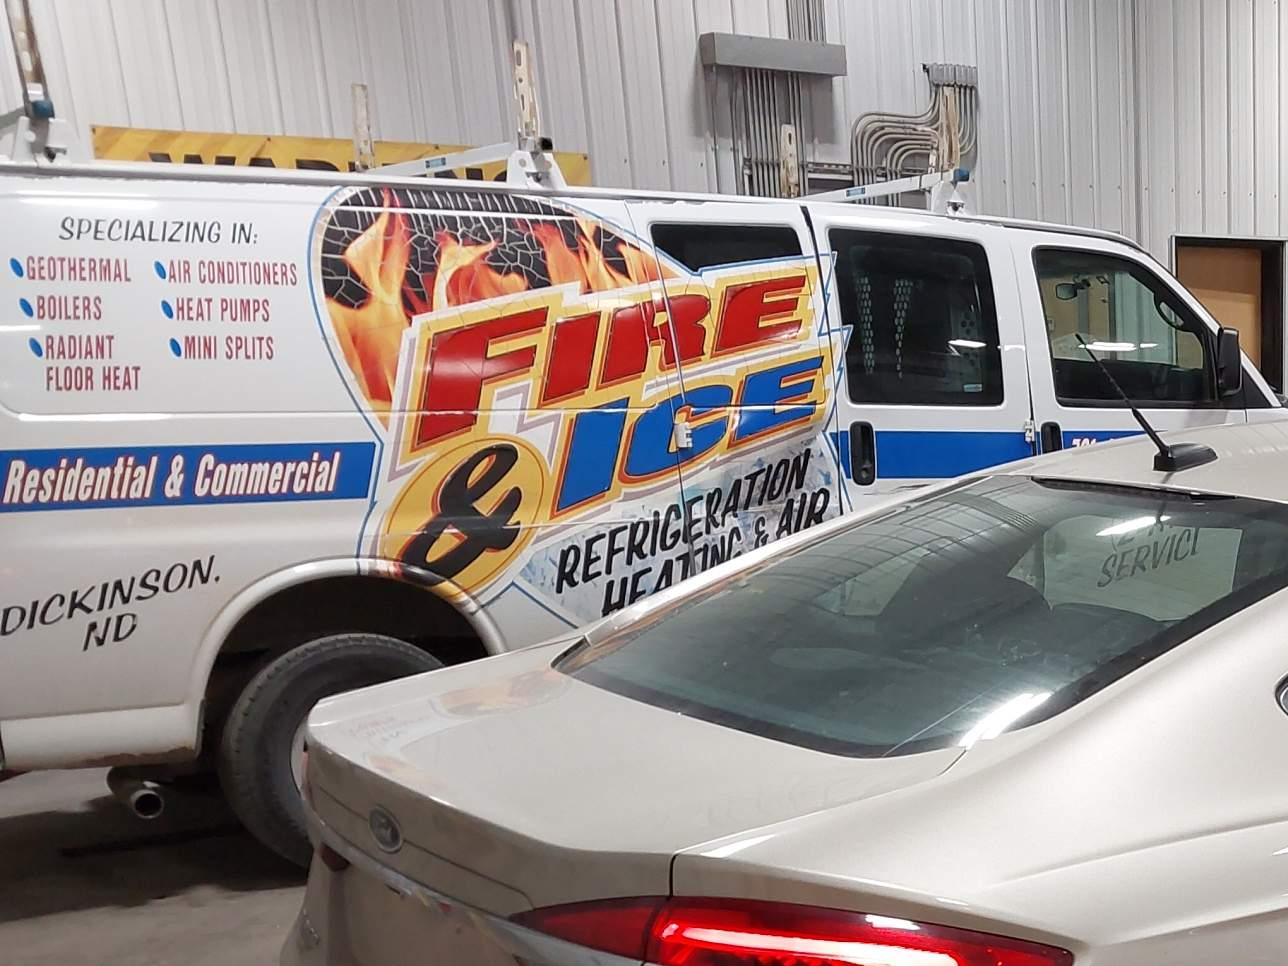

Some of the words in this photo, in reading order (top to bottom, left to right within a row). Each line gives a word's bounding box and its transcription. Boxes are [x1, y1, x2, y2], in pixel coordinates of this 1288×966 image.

[58, 216, 221, 244] SPECIALIZING
[230, 222, 258, 245] IN:
[26, 256, 132, 283] GEOTHERMAL
[168, 260, 192, 285] AIR
[199, 260, 298, 287] CONDITIONERS
[36, 295, 102, 321] BOILERS
[176, 297, 213, 323] HEAT
[220, 298, 271, 323] PUMPS
[45, 334, 115, 361] RADIANT
[184, 336, 217, 360] MINI
[225, 336, 274, 361] SPLITS
[413, 275, 808, 450] FIRE
[46, 366, 94, 392] FLOOR
[102, 366, 141, 391] HEAT
[4, 455, 158, 504] Residential
[164, 454, 185, 499] &
[194, 450, 341, 498] Commercial
[400, 443, 522, 586] &
[553, 355, 826, 518] ICE
[555, 448, 811, 594] REFRIGERATION
[754, 516, 769, 549] &
[775, 487, 831, 541] AIR
[0, 554, 221, 637] DICKINSON.
[83, 612, 138, 652] ND
